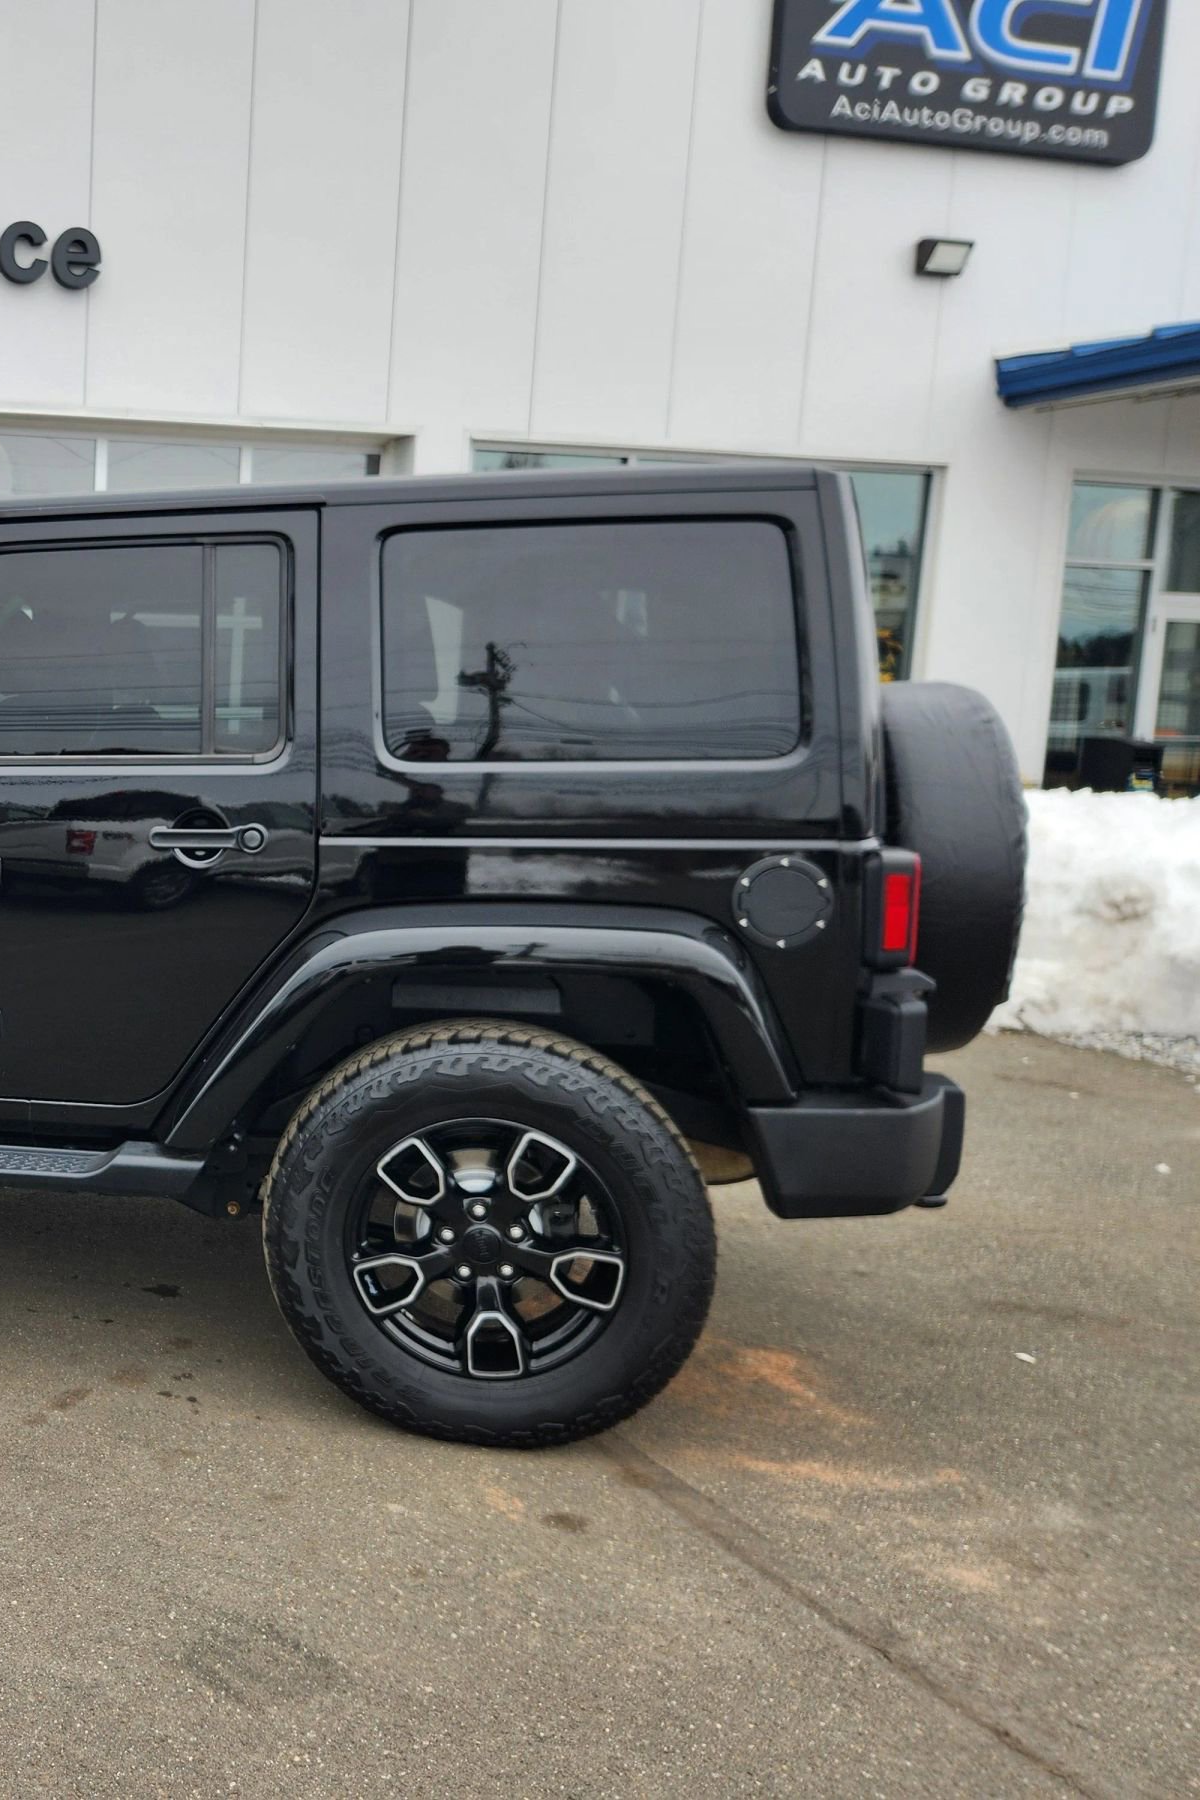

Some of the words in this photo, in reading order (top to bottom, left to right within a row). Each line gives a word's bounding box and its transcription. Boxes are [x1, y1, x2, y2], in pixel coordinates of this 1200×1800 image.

[797, 58, 940, 95] AUTO
[961, 77, 1135, 118] GROUP
[830, 95, 1109, 148] AciAutoGroup.com
